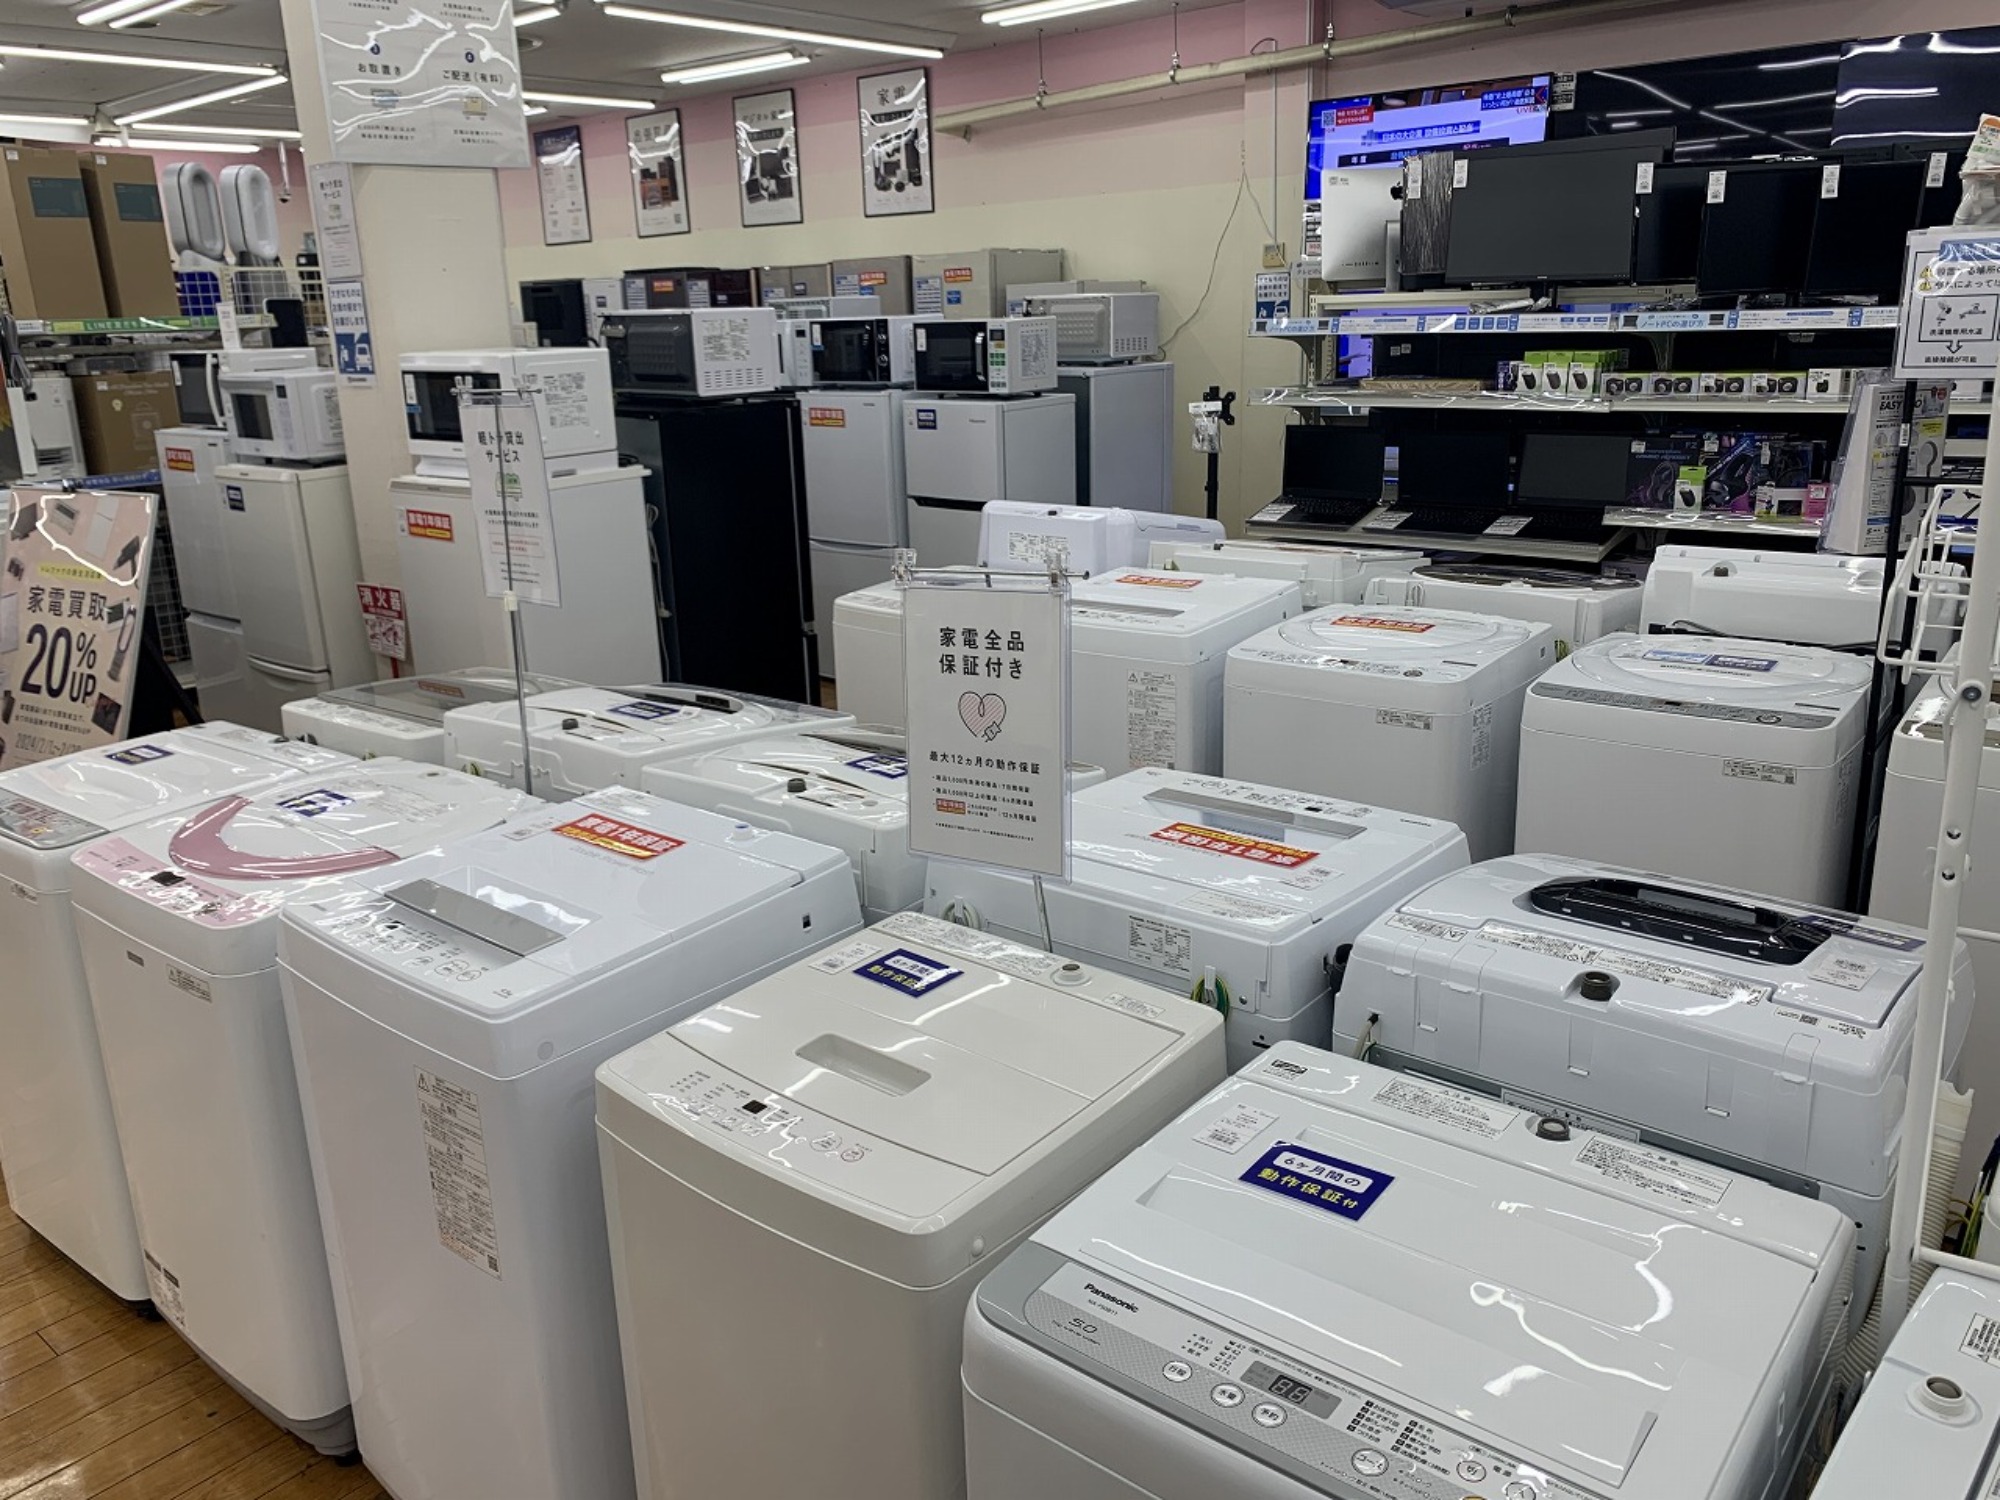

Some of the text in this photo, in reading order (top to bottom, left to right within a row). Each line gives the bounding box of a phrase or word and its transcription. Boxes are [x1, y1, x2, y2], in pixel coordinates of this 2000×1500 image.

[357, 62, 402, 76] お取置き
[25, 585, 108, 622] 家電買取
[939, 626, 1026, 653] 家電全品
[938, 653, 1024, 680] 保証付き
[69, 671, 98, 706] UP
[576, 816, 681, 852] 家電1年保証
[1257, 1167, 1359, 1210] 動作保証付
[1083, 1282, 1140, 1314] Panasonic
[1260, 1407, 1279, 1421] 予約
[1356, 1453, 1384, 1470] コース
